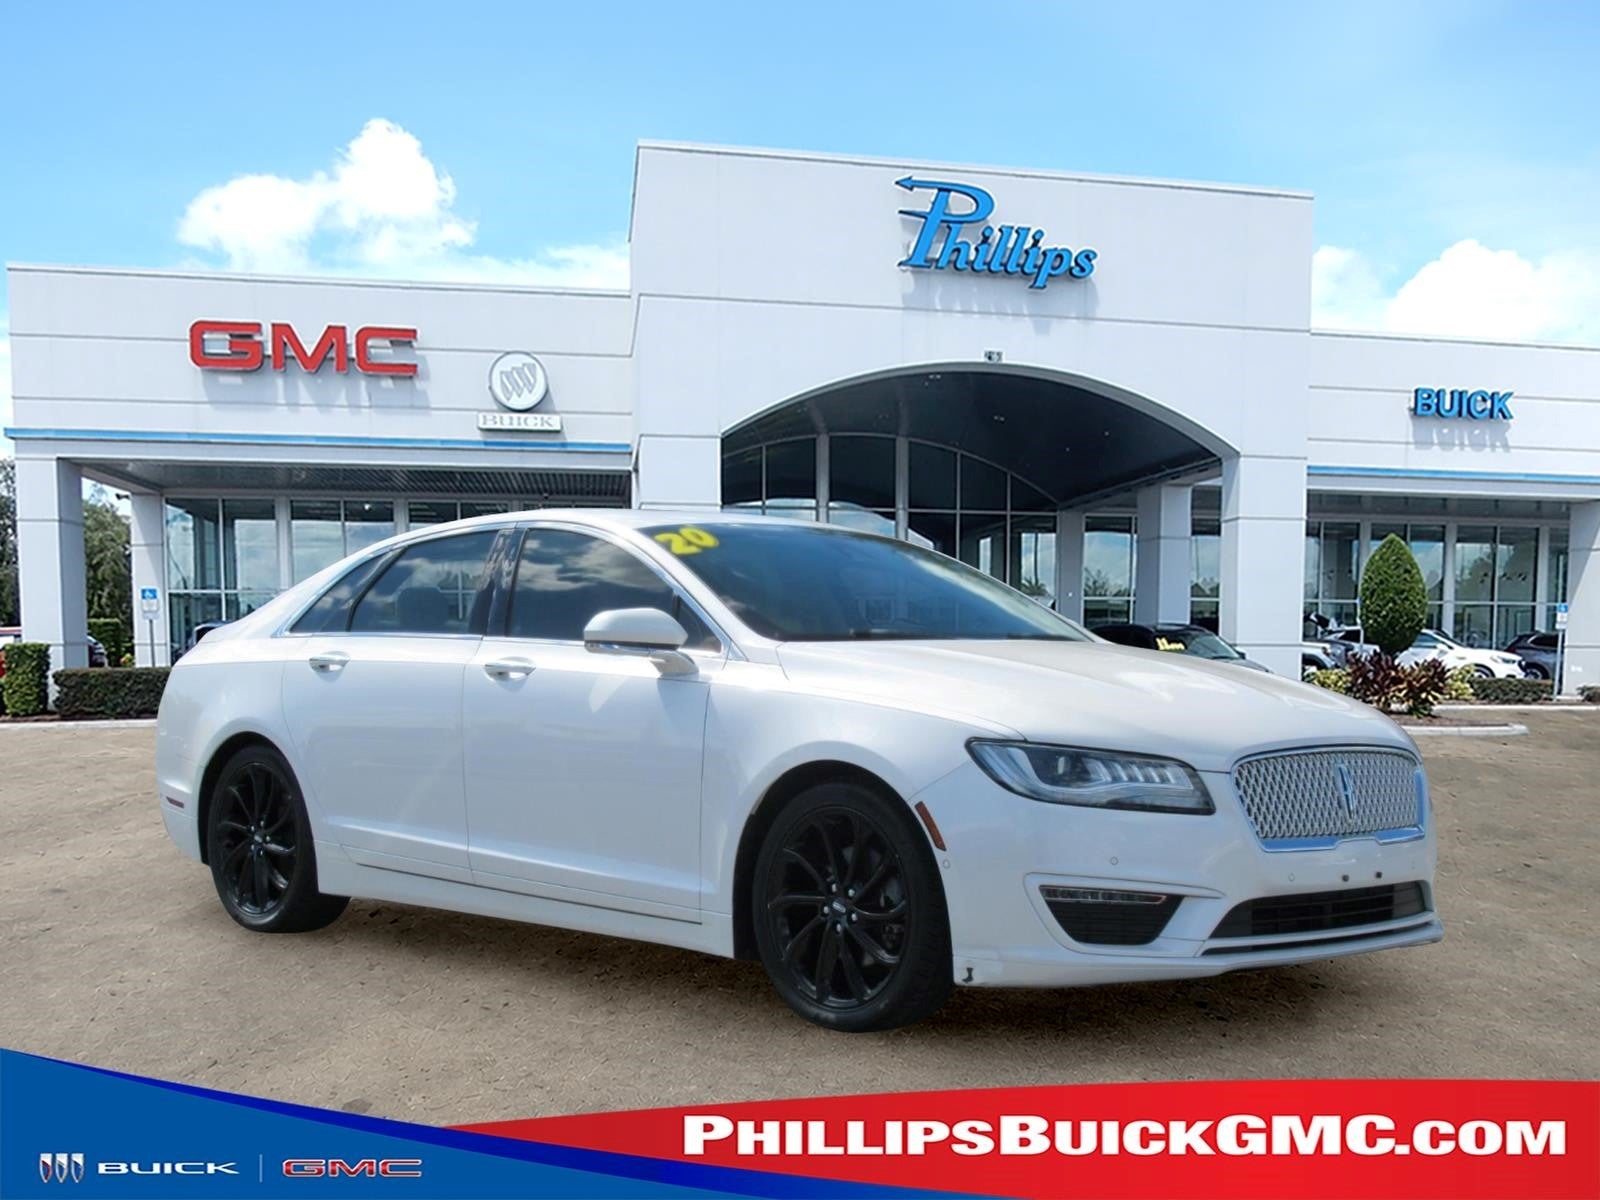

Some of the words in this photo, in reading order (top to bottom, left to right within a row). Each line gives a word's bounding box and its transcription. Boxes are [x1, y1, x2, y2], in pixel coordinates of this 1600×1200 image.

[894, 177, 1098, 290] Phillips
[190, 319, 418, 377] GMC
[1413, 387, 1515, 420] BUICK
[481, 414, 555, 428] BUICK
[653, 526, 719, 555] 20
